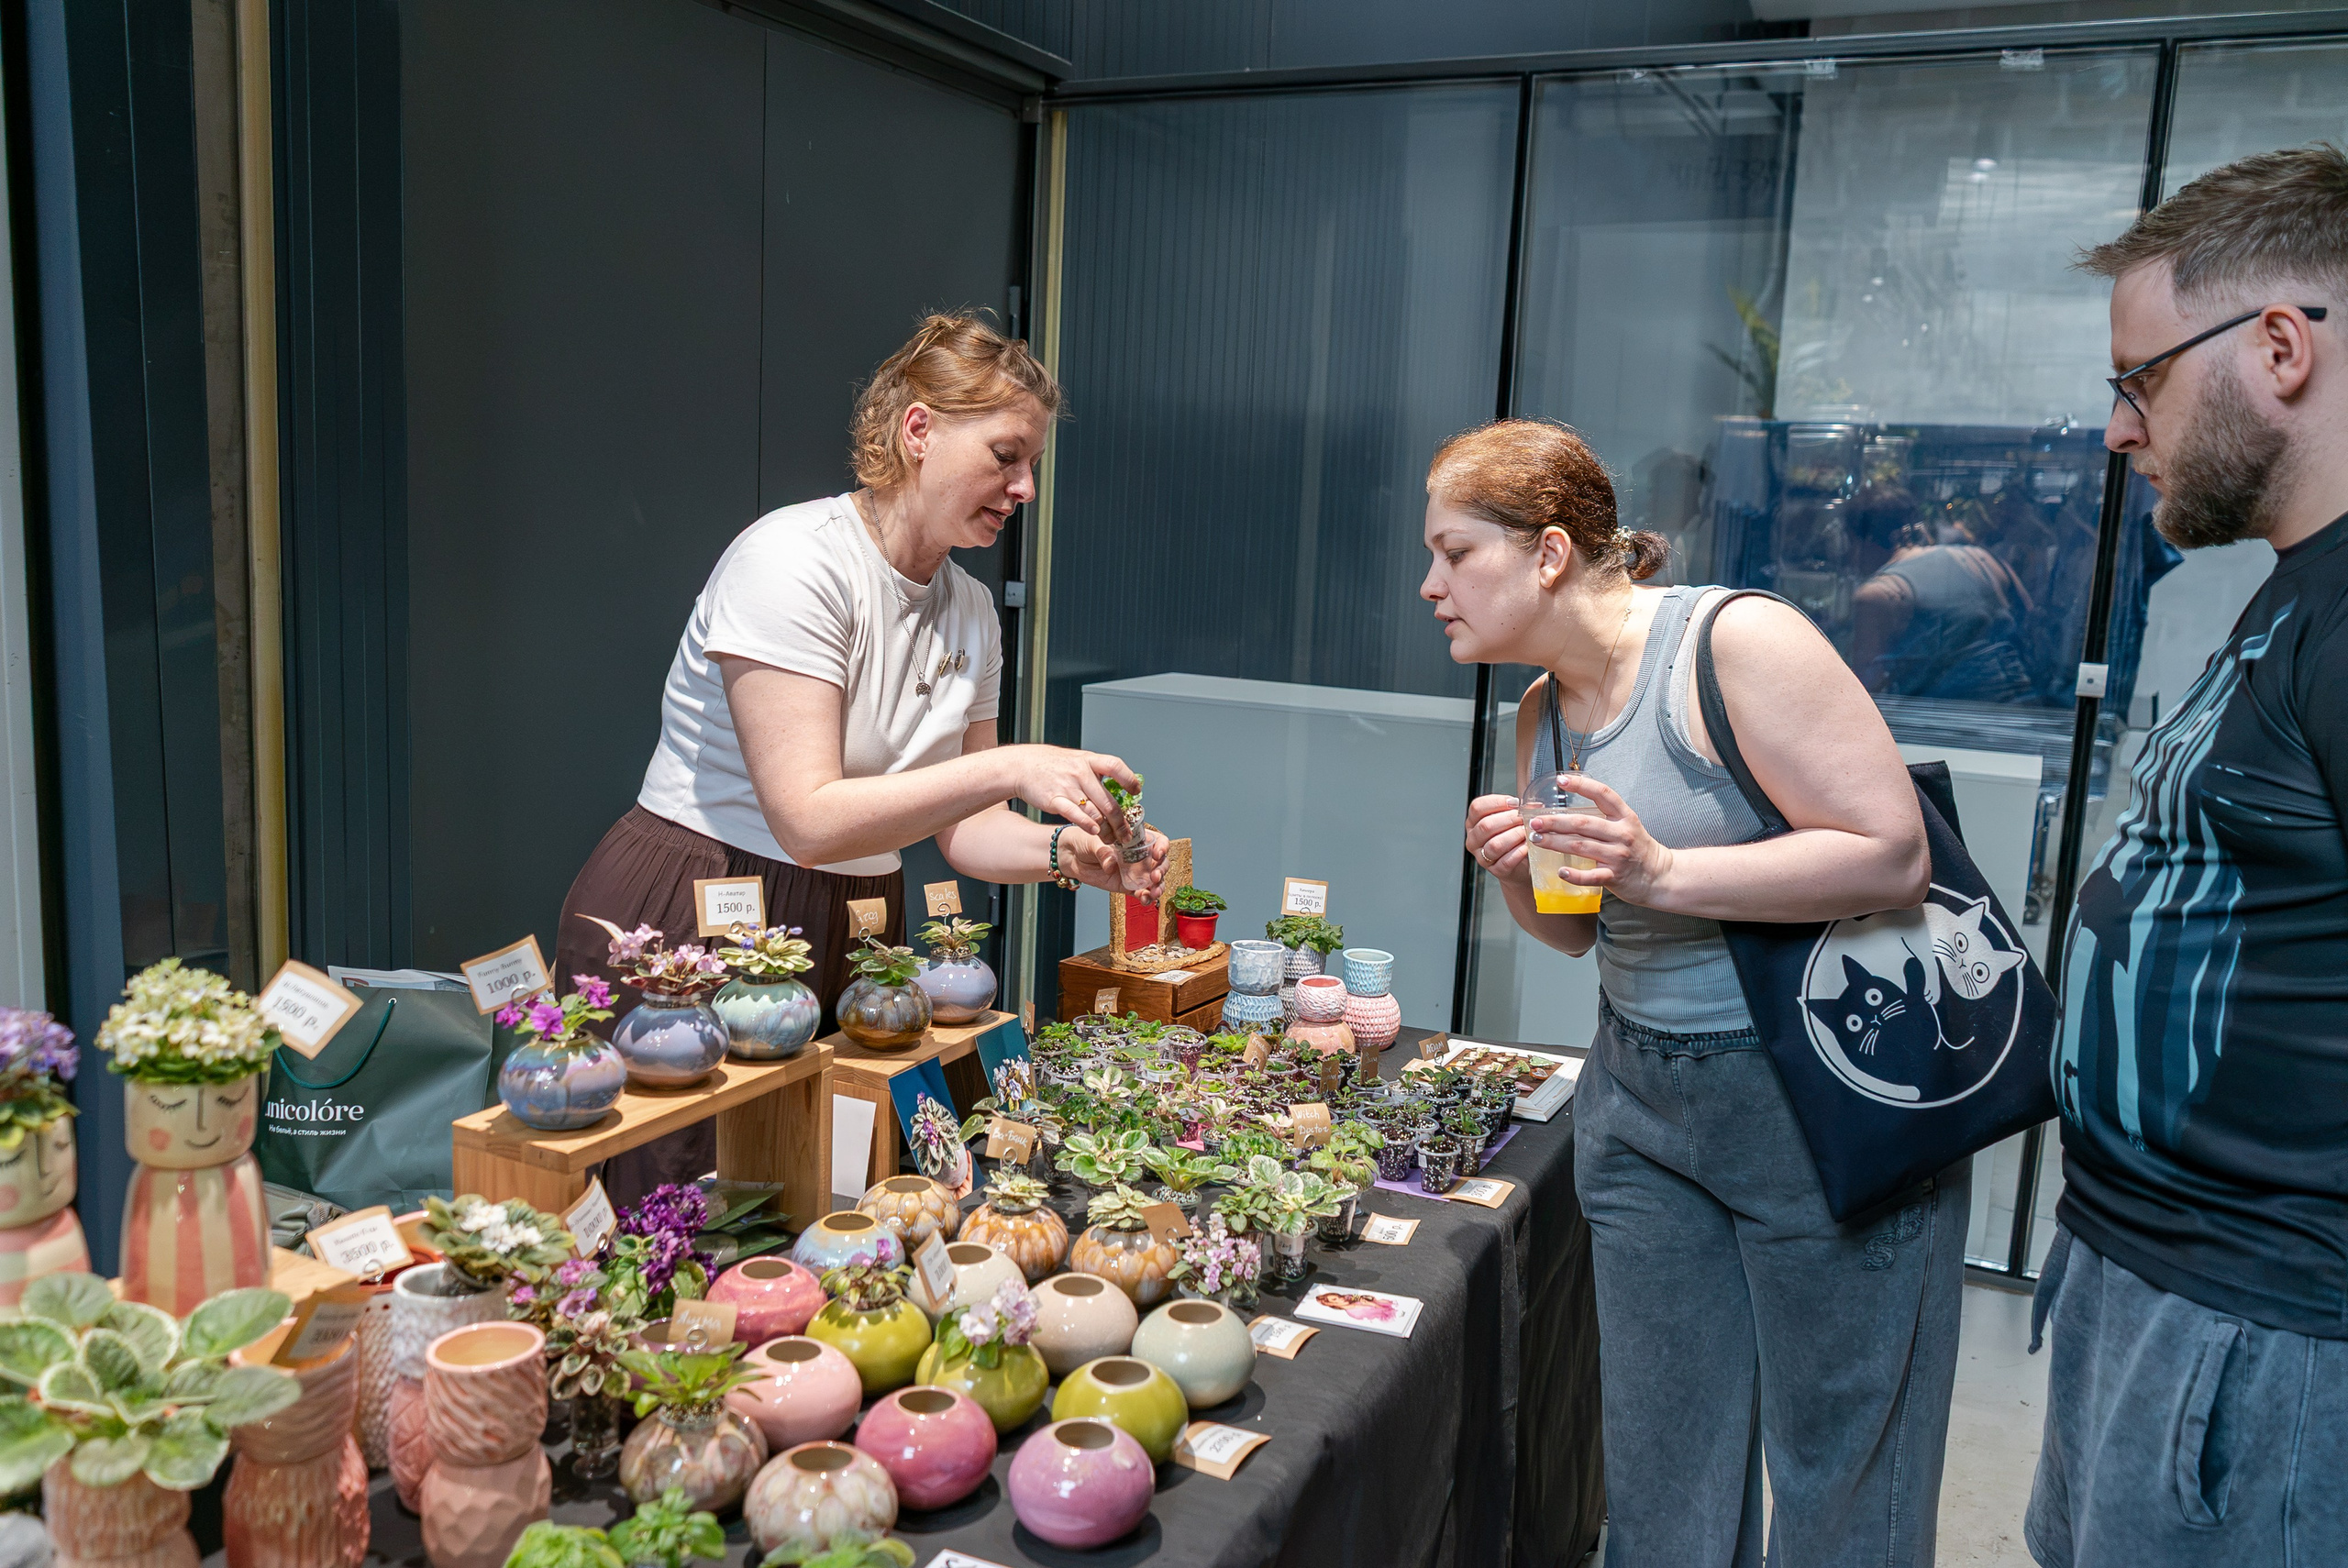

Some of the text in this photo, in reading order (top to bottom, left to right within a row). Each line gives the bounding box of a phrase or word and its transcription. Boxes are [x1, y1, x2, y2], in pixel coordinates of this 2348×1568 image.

[717, 902, 742, 913] 1500
[1295, 898, 1312, 906] 1500
[486, 973, 519, 994] 1000
[272, 996, 307, 1019] 1500
[1294, 1108, 1320, 1120] Witch
[1298, 1123, 1329, 1135] Doctor
